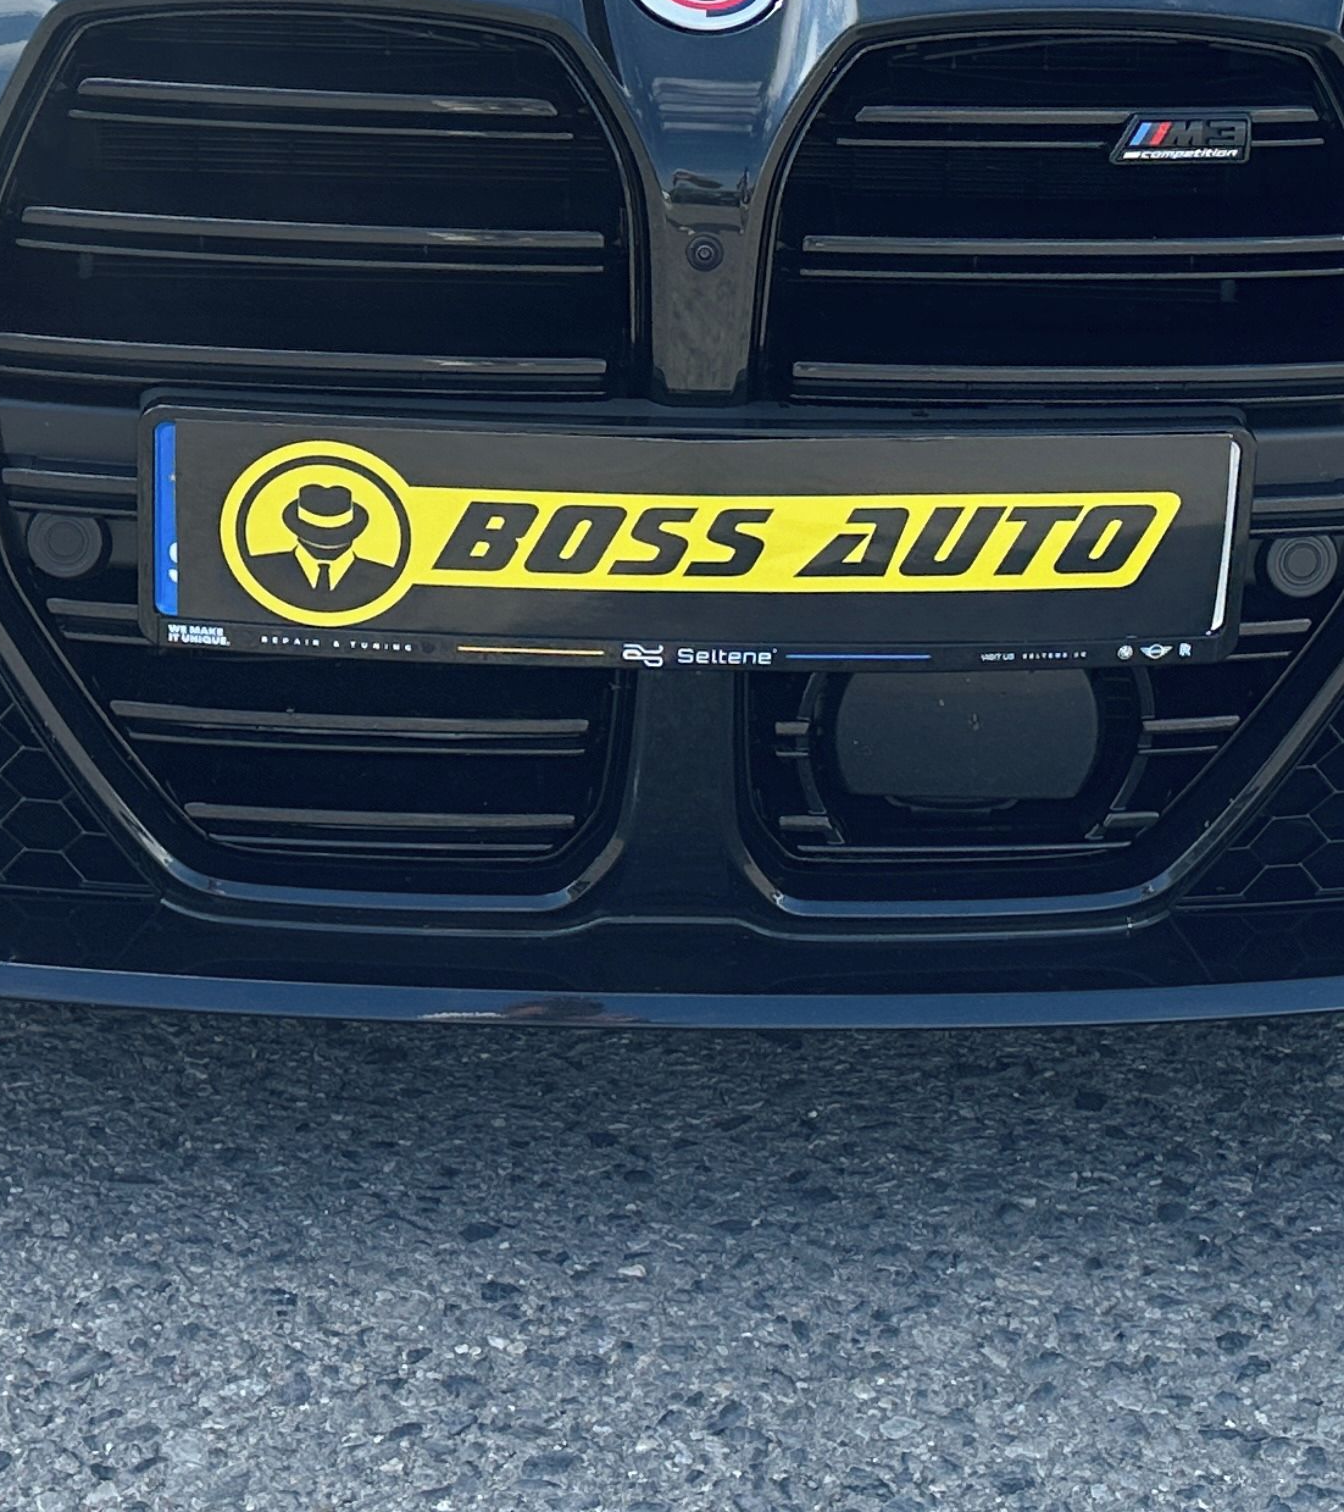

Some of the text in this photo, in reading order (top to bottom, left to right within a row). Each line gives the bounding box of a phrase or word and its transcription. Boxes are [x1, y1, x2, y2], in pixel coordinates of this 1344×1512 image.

[1160, 120, 1247, 147] M3
[1140, 148, 1239, 160] competition
[431, 500, 1159, 578] BOSS AUTO
[168, 624, 224, 637] WE MAKE
[168, 633, 179, 643] IT
[350, 641, 412, 652] TUNING
[677, 647, 772, 665] Seltene
